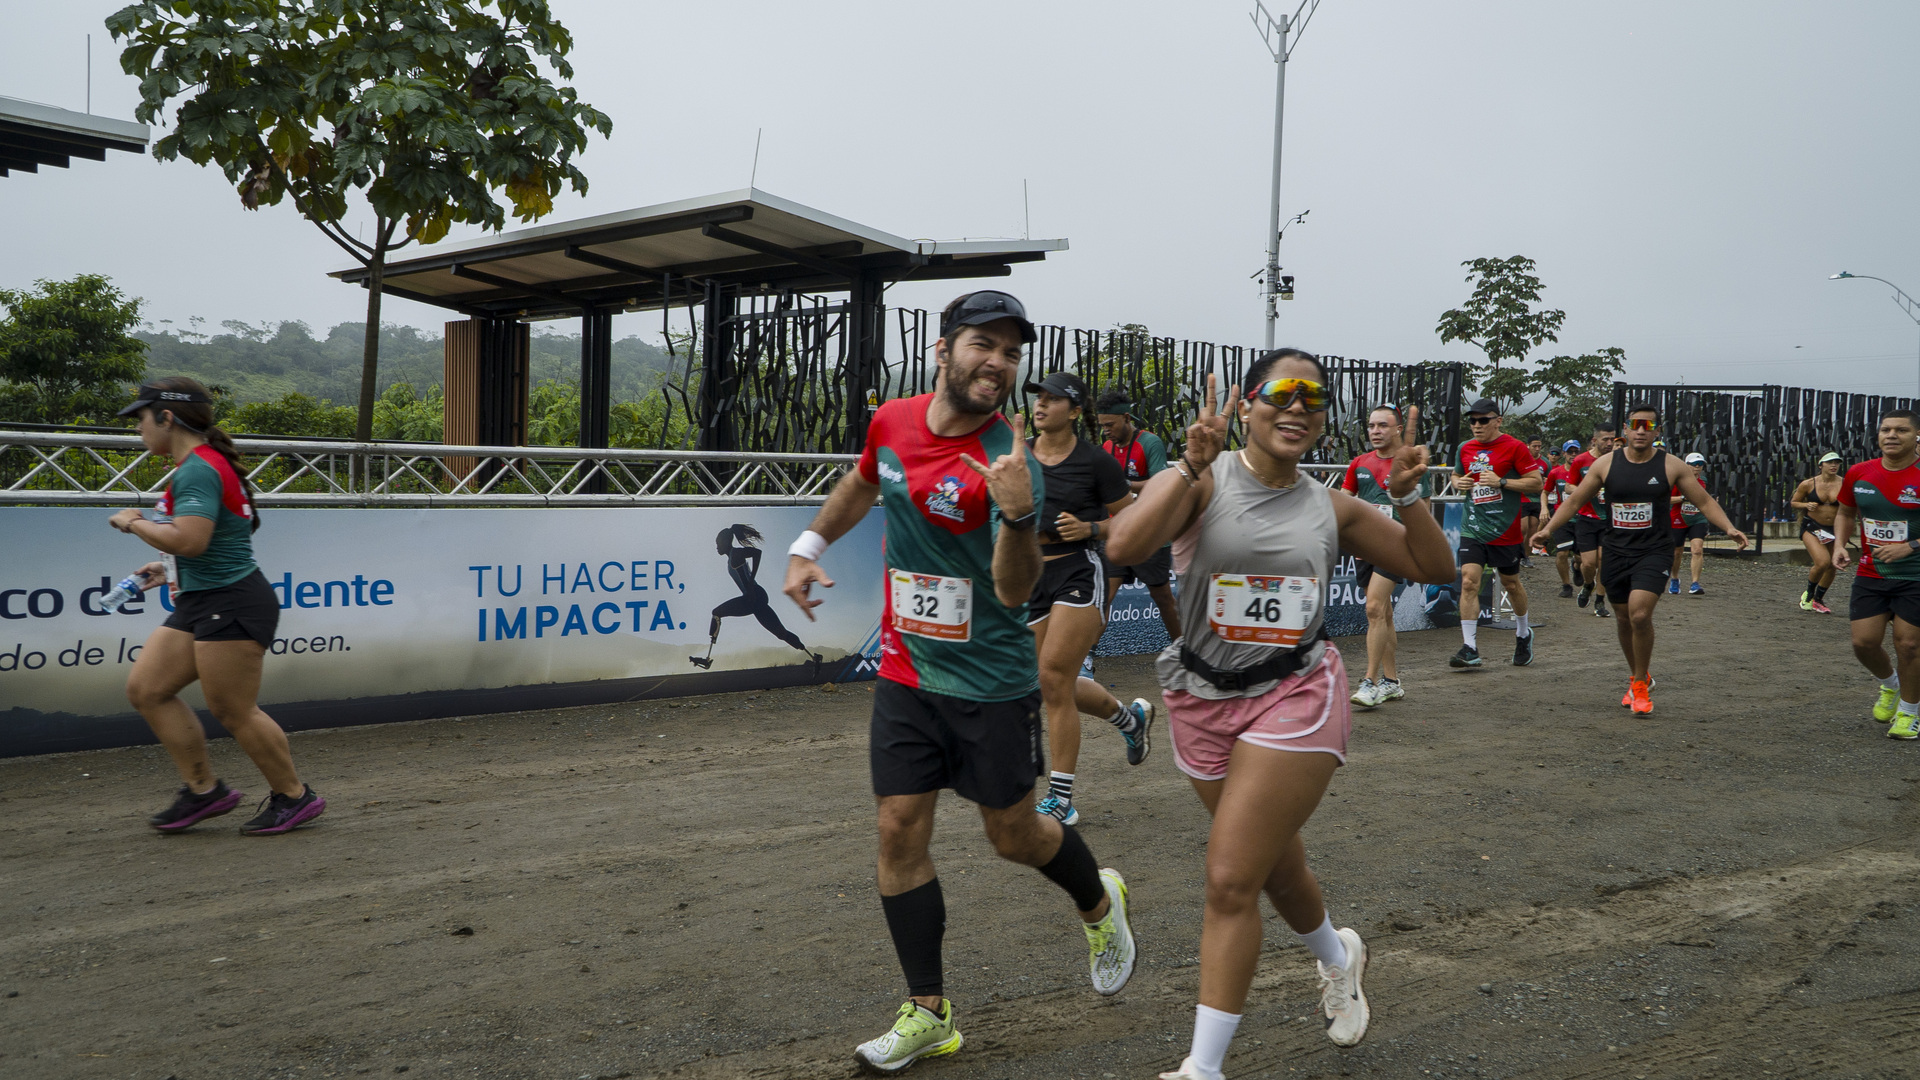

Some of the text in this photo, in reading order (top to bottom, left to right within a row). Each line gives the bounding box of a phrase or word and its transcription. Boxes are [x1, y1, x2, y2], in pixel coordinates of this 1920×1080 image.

[1618, 511, 1646, 521] 1726
[1871, 528, 1894, 539] 450
[469, 560, 686, 597] TU HACER,
[79, 576, 146, 616] de
[912, 593, 939, 618] 32
[478, 600, 688, 642] IMPACTA.
[1108, 602, 1160, 622] lado de
[1244, 597, 1282, 623] 46
[58, 640, 105, 667] de
[269, 634, 352, 655] acen.
